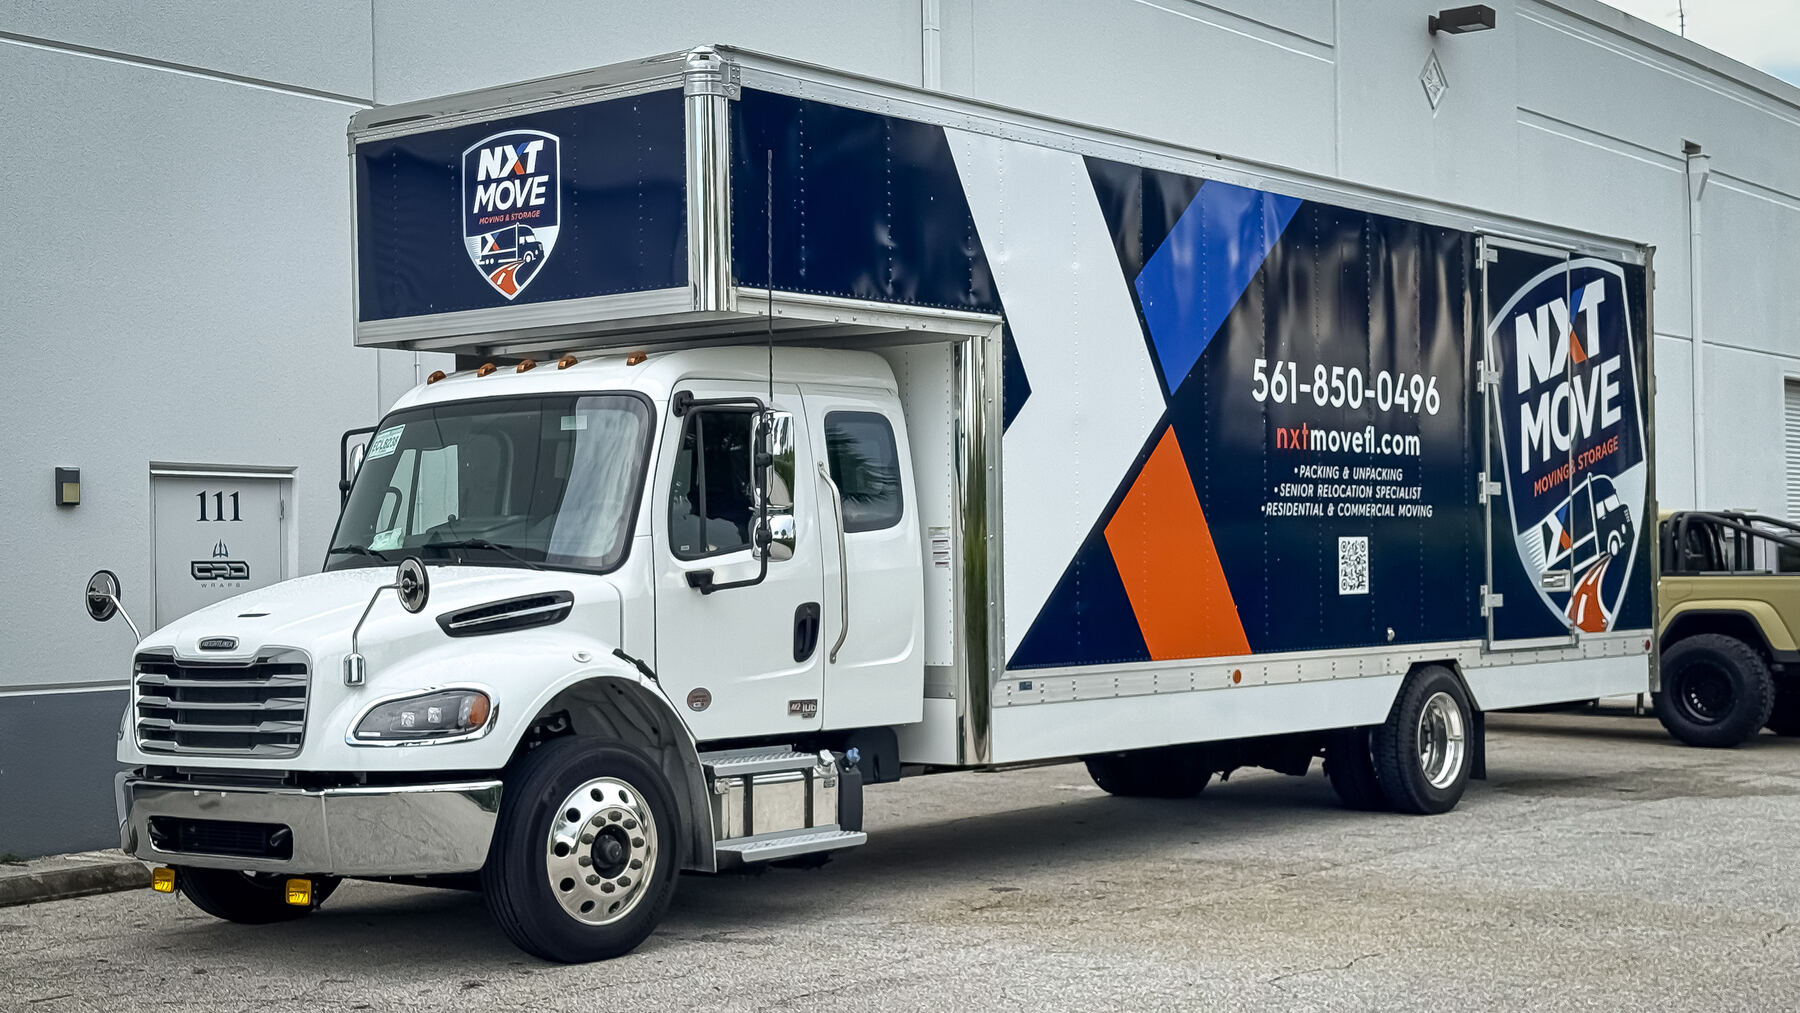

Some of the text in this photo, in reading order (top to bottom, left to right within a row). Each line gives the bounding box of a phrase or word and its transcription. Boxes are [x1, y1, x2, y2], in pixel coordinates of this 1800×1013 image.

[477, 139, 544, 181] NXT
[473, 175, 549, 214] MOVE
[479, 214, 504, 225] MOVING
[511, 210, 541, 220] STORAGE
[1515, 277, 1605, 395] NXT
[1252, 358, 1440, 415] 561-850-0496
[1520, 354, 1622, 475] MOVE
[1276, 422, 1421, 456] nxtmovefl.com
[1342, 466, 1350, 480] &
[1352, 467, 1403, 481] UNPACKING
[1534, 462, 1570, 497] MOVING
[1577, 435, 1619, 471] STORAGE
[196, 490, 243, 522] 111
[1317, 484, 1373, 498] RELOCATION
[1375, 486, 1422, 500] SPECIALIST
[1327, 503, 1335, 516] &
[1337, 503, 1395, 517] COMMERCIAL
[1398, 504, 1433, 518] MOVING
